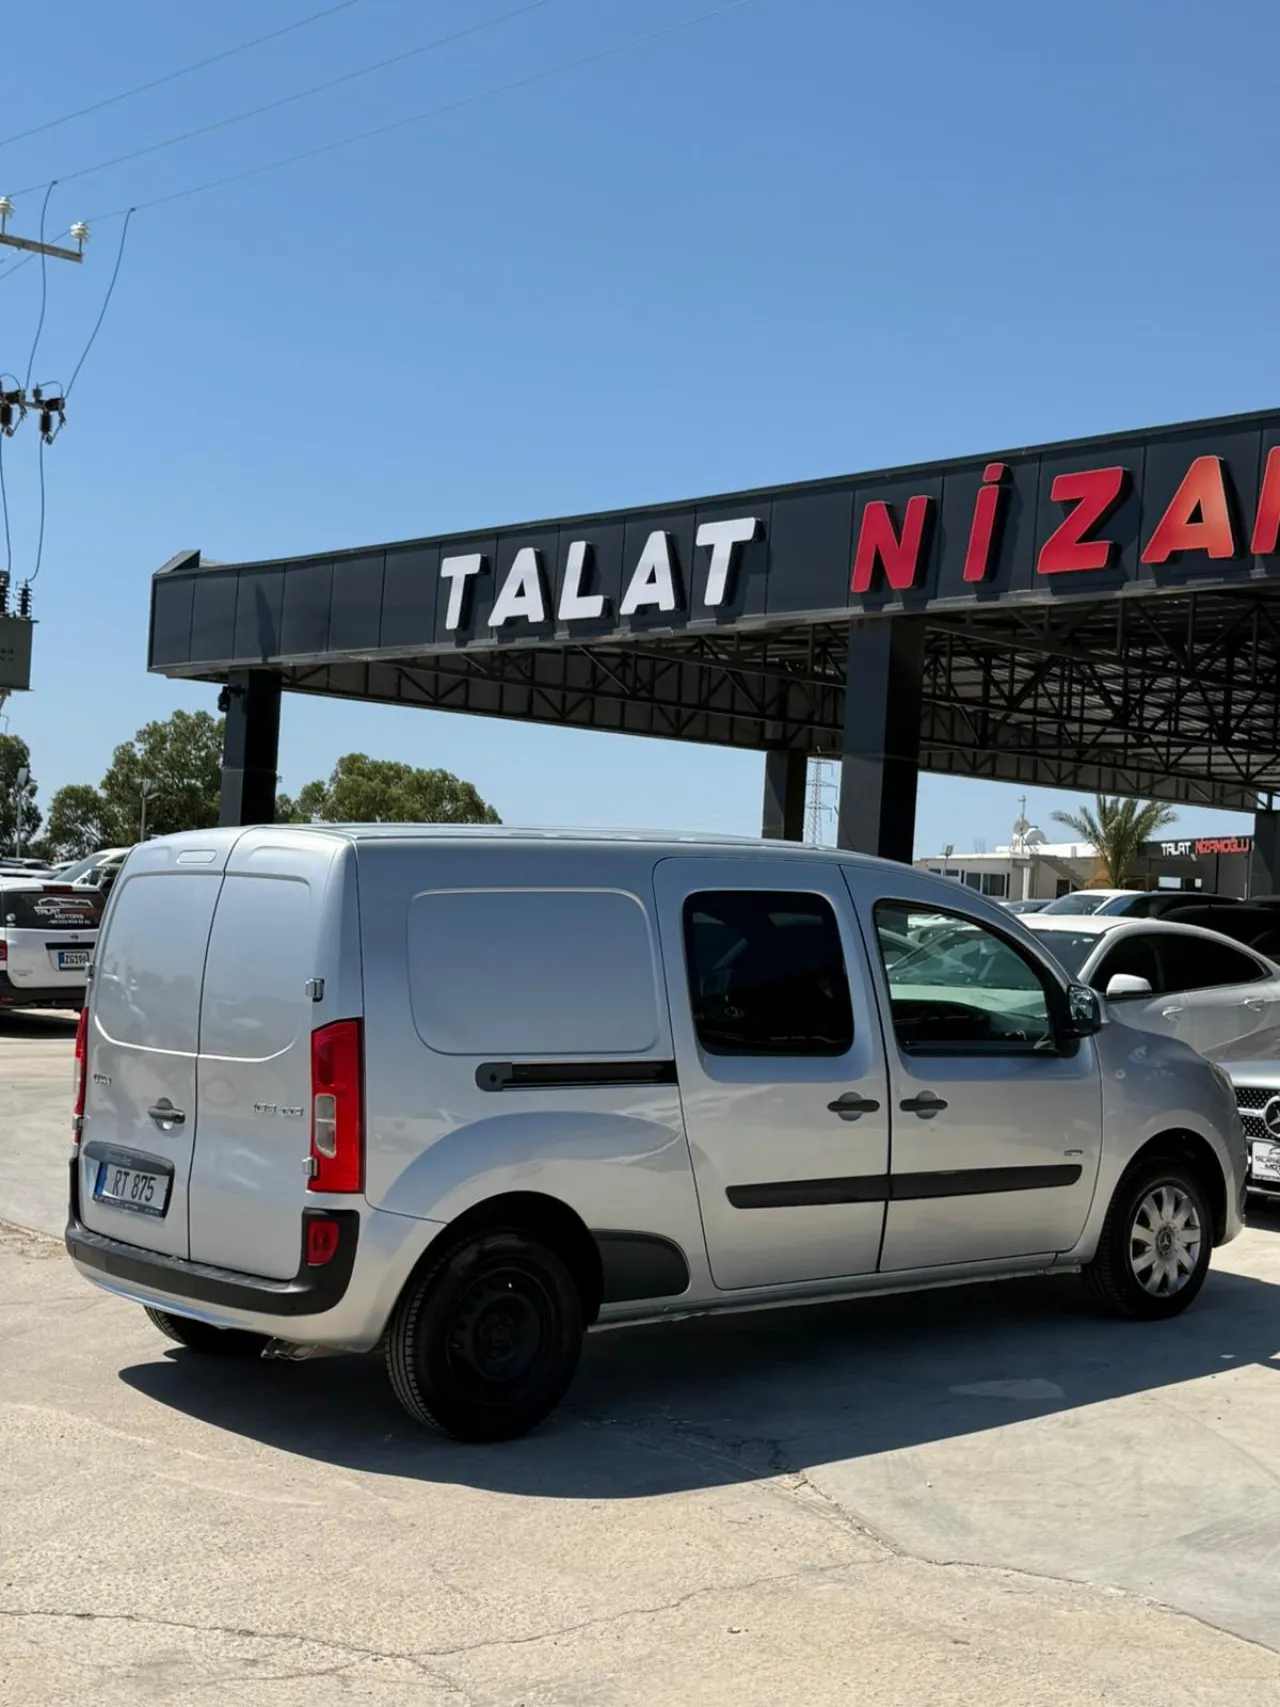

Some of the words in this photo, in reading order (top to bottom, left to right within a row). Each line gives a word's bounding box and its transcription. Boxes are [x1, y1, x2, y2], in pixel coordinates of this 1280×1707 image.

[441, 517, 757, 630] TALAT
[1161, 841, 1191, 856] TALAT
[112, 1169, 130, 1197] RT
[131, 1174, 157, 1202] 875
